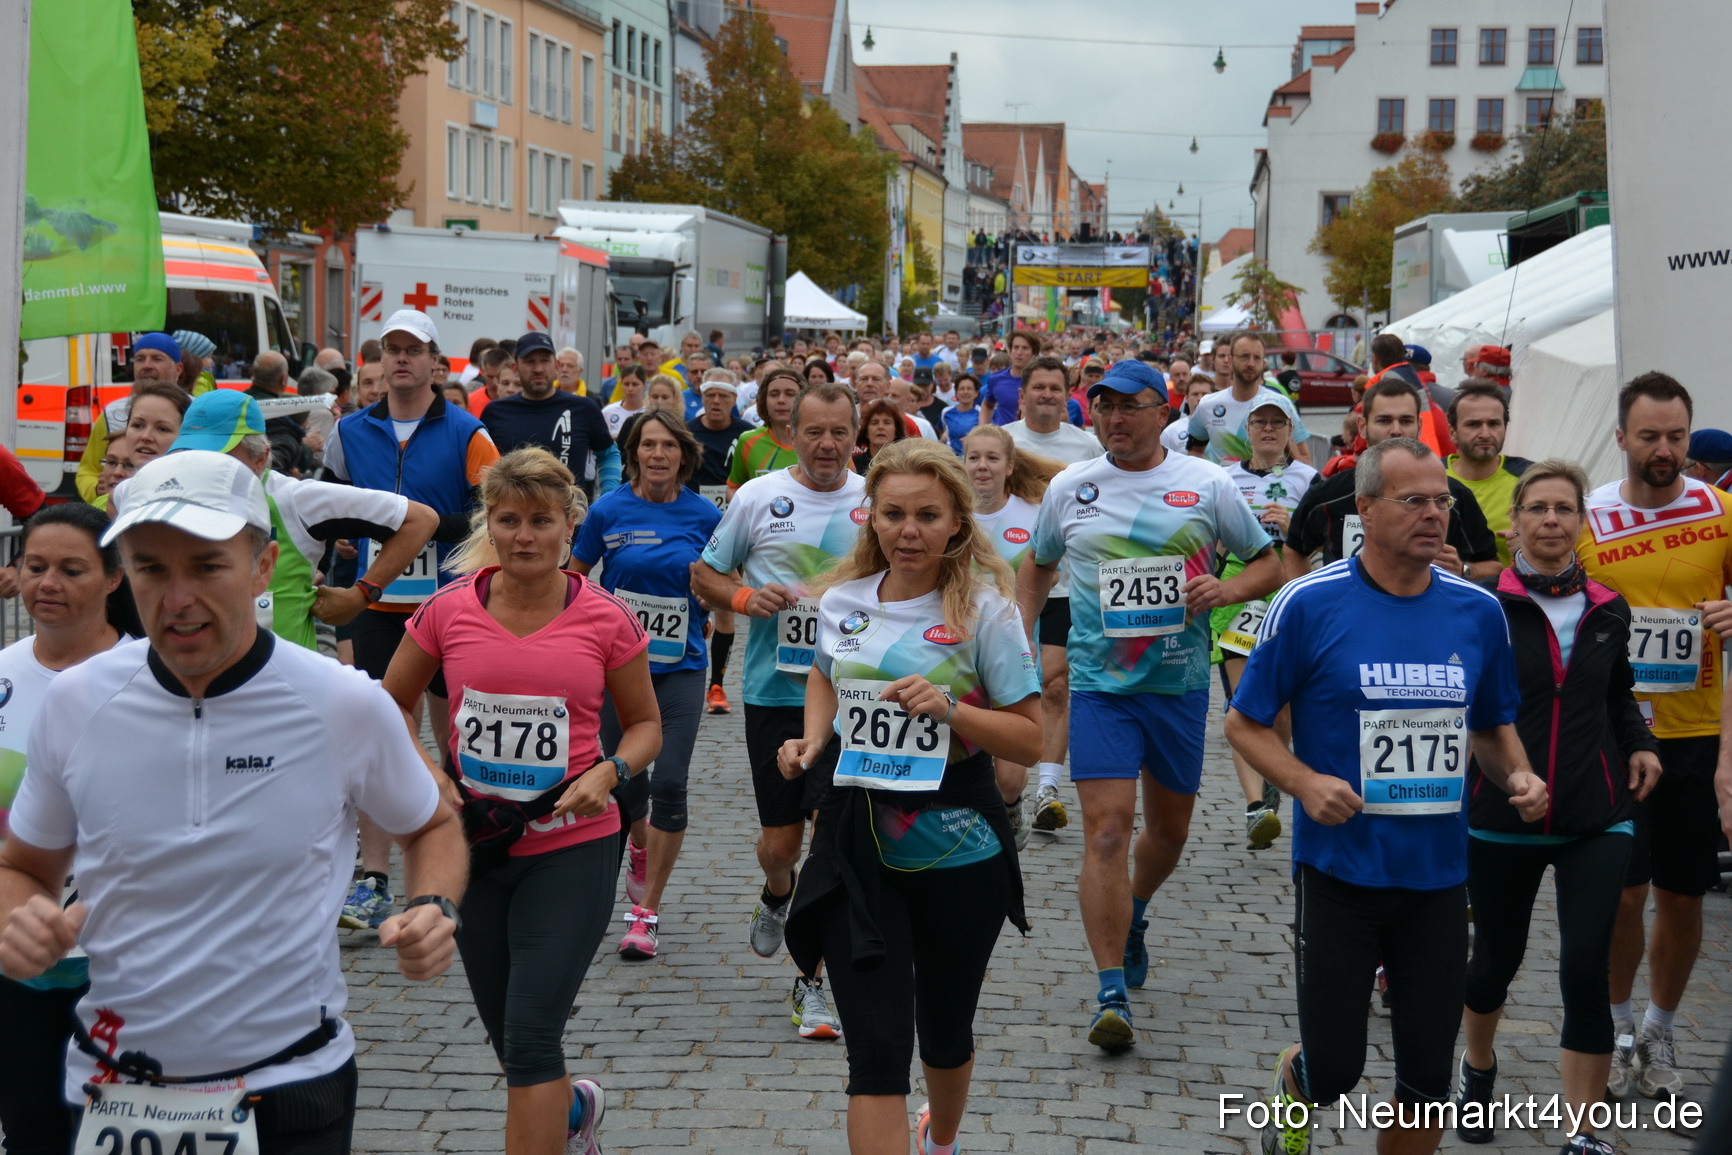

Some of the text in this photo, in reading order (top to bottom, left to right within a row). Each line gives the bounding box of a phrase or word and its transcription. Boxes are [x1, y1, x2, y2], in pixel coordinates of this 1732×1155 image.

[1056, 272, 1103, 283] START
[445, 284, 509, 297] Bayerisches
[444, 297, 474, 308] Rotes
[443, 310, 474, 321] Kreuz
[155, 484, 185, 493] adidas
[1168, 493, 1196, 503] Hervis
[1076, 506, 1100, 516] PARTL
[1076, 512, 1100, 520] Neumarkt
[770, 521, 796, 530] PARTL
[1007, 531, 1028, 540] Hervis
[1597, 524, 1729, 566] MAX BÖGL
[1101, 564, 1172, 576] PARTL Neumarkt
[1110, 575, 1180, 607] 2453
[641, 601, 677, 611] Neumarkt
[637, 610, 682, 639] 042
[1127, 610, 1163, 626] Lothar
[1237, 612, 1264, 635] 27
[1640, 615, 1685, 625] Neumarkt
[786, 615, 817, 645] 30
[837, 637, 860, 649] PARTL
[1162, 635, 1181, 649] 16.
[1632, 628, 1692, 660] 719
[1359, 662, 1466, 689] HUBER
[1633, 669, 1679, 681] hristian
[840, 689, 875, 701] PARTL
[1385, 688, 1463, 699] TECHNOLOGY
[463, 698, 549, 716] PARTL Neumarkt
[849, 706, 939, 752] 2673
[1363, 719, 1451, 730] PARTL Neumarkt
[465, 716, 558, 762] 2178
[1373, 734, 1460, 774] 2175
[226, 755, 275, 770] kalas
[861, 757, 912, 777] Denisa
[480, 765, 536, 786] Daniela
[1388, 783, 1448, 799] Christian
[89, 1101, 225, 1121] PARTL Neumarkt
